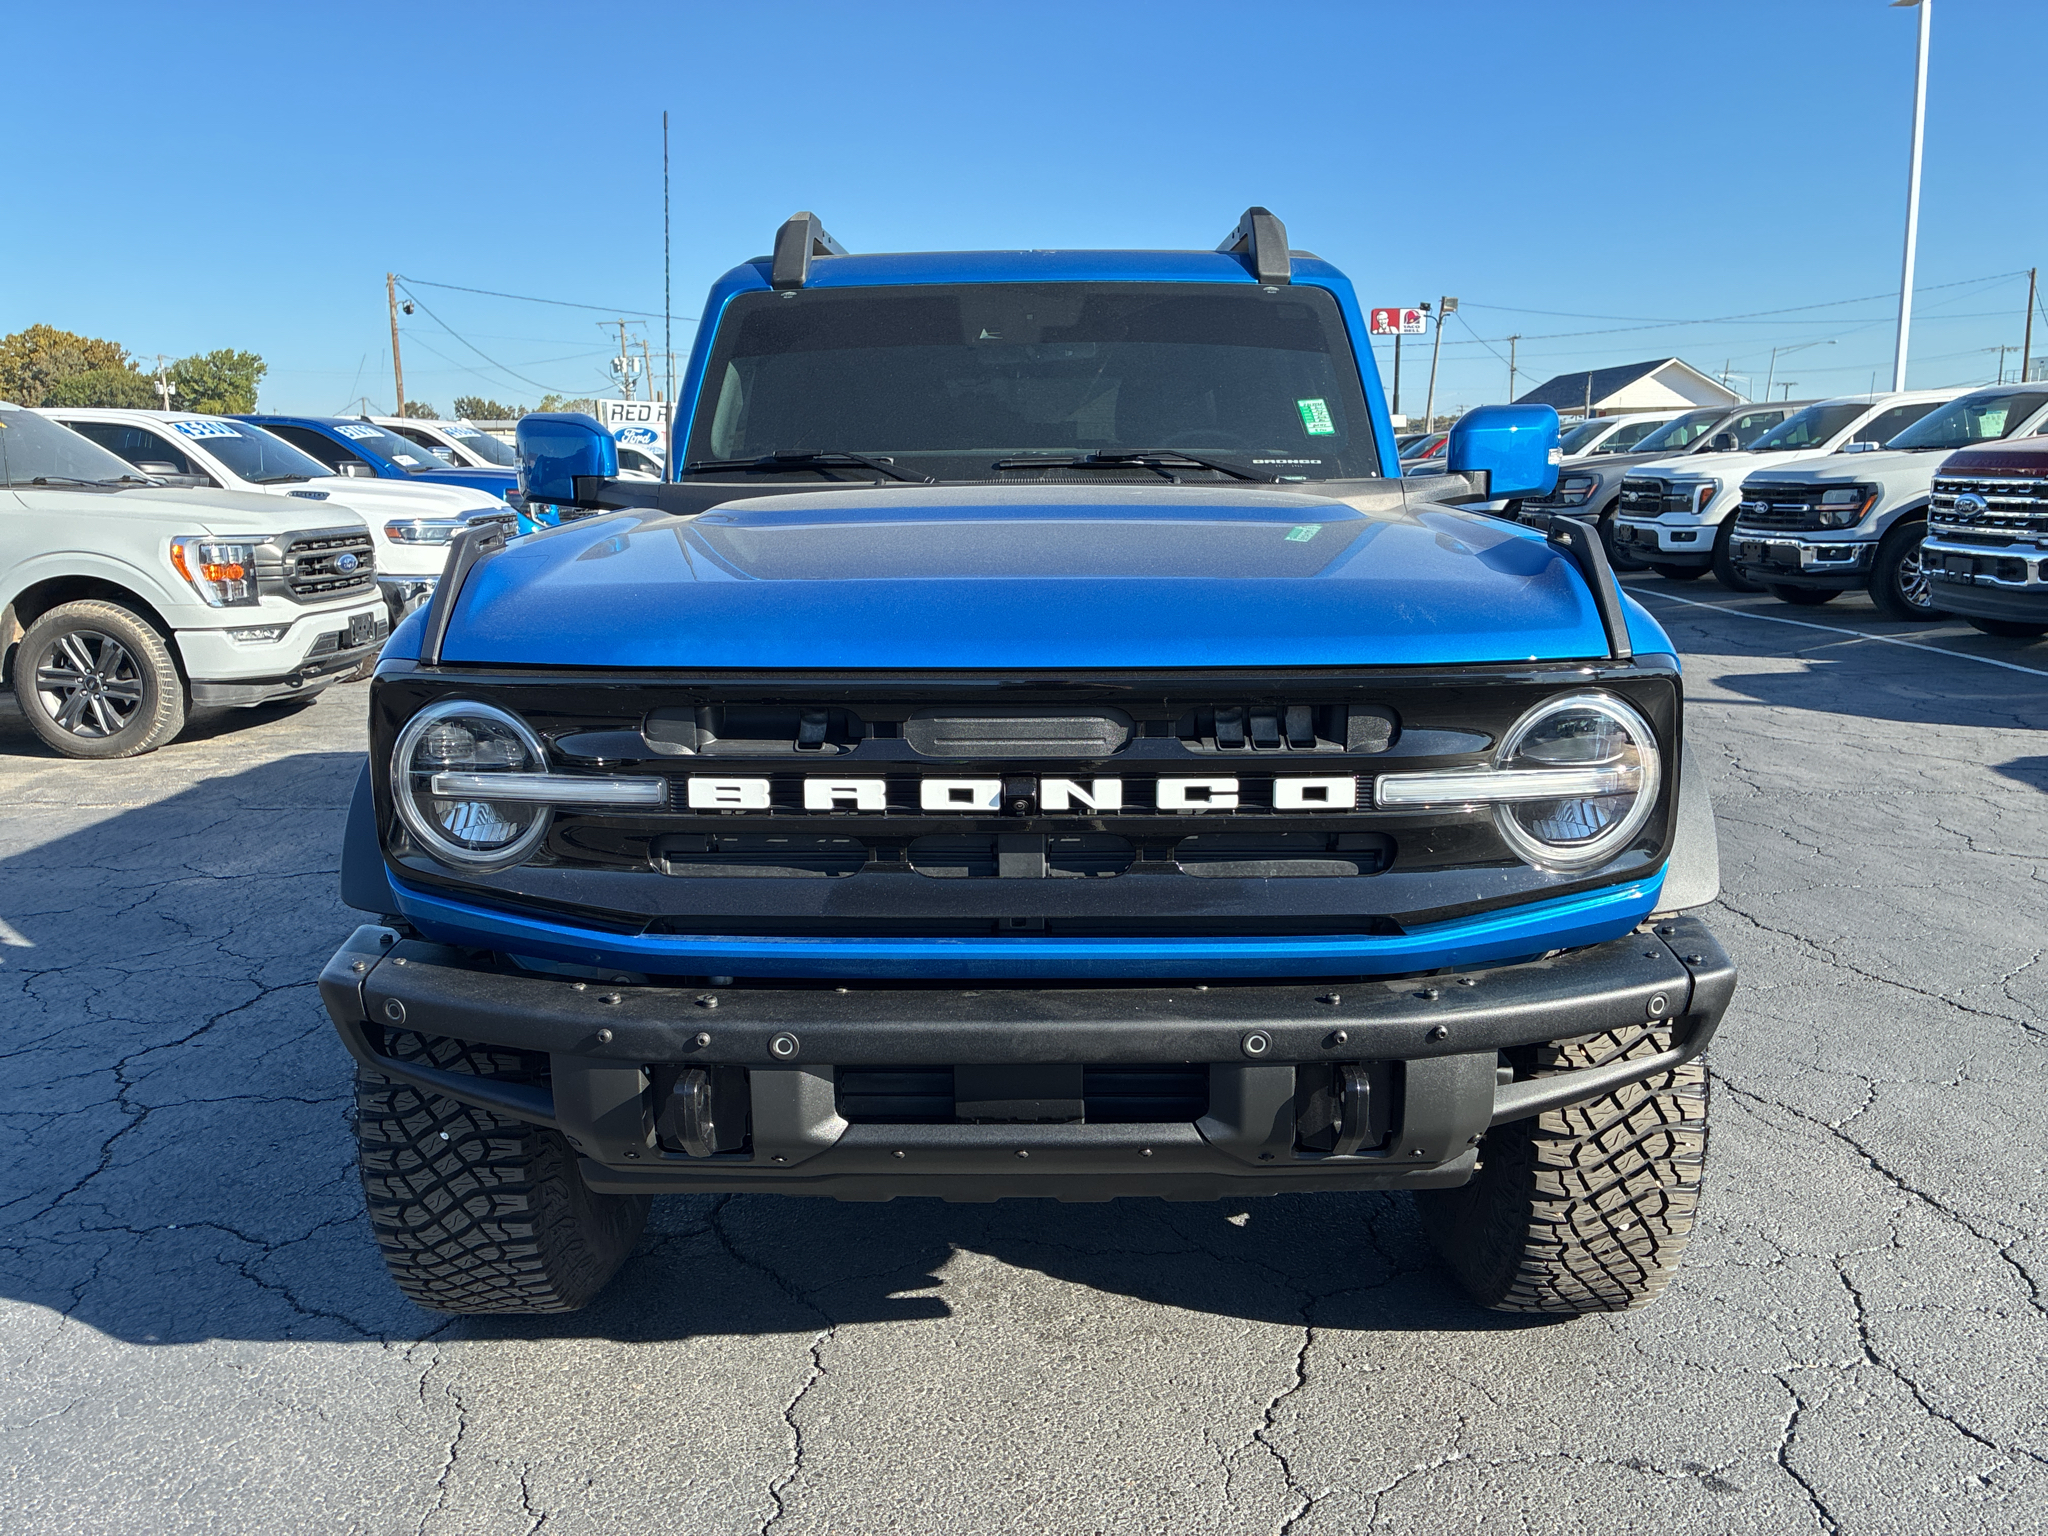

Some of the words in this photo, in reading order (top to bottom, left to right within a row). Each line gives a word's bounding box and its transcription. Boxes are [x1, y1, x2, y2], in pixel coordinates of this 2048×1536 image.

[611, 404, 651, 421] RED
[621, 428, 651, 445] Ford
[688, 777, 1357, 810] BRONCO
